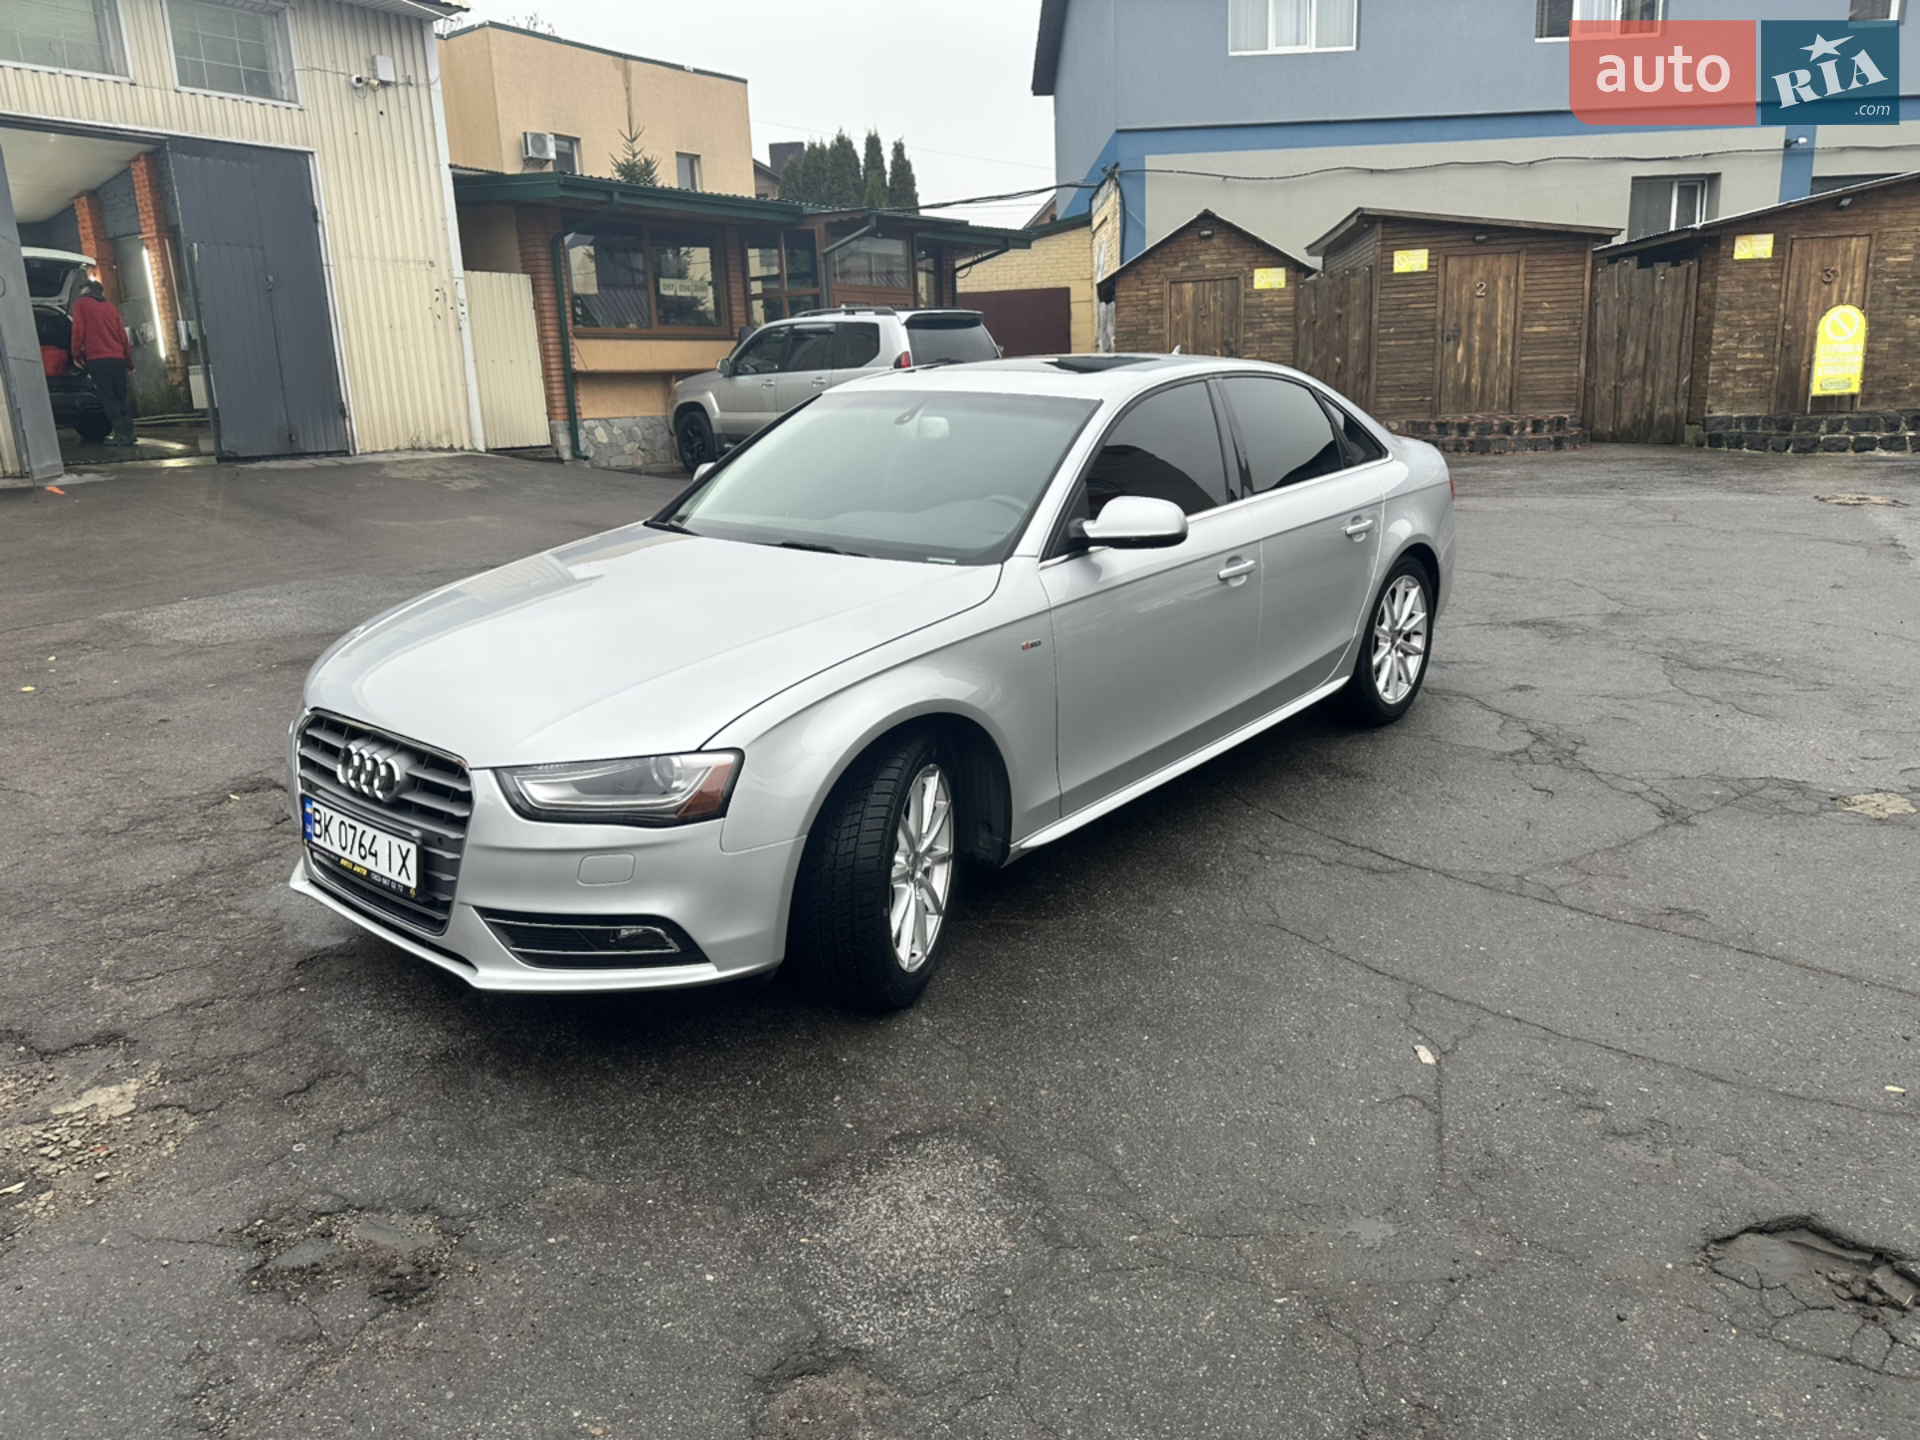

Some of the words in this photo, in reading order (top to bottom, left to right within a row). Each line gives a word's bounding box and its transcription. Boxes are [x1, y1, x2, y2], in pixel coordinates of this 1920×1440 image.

[1822, 267, 1834, 284] 3
[1475, 281, 1486, 297] 2
[313, 807, 333, 846] BK
[339, 820, 378, 867] 0764
[388, 840, 411, 881] IX
